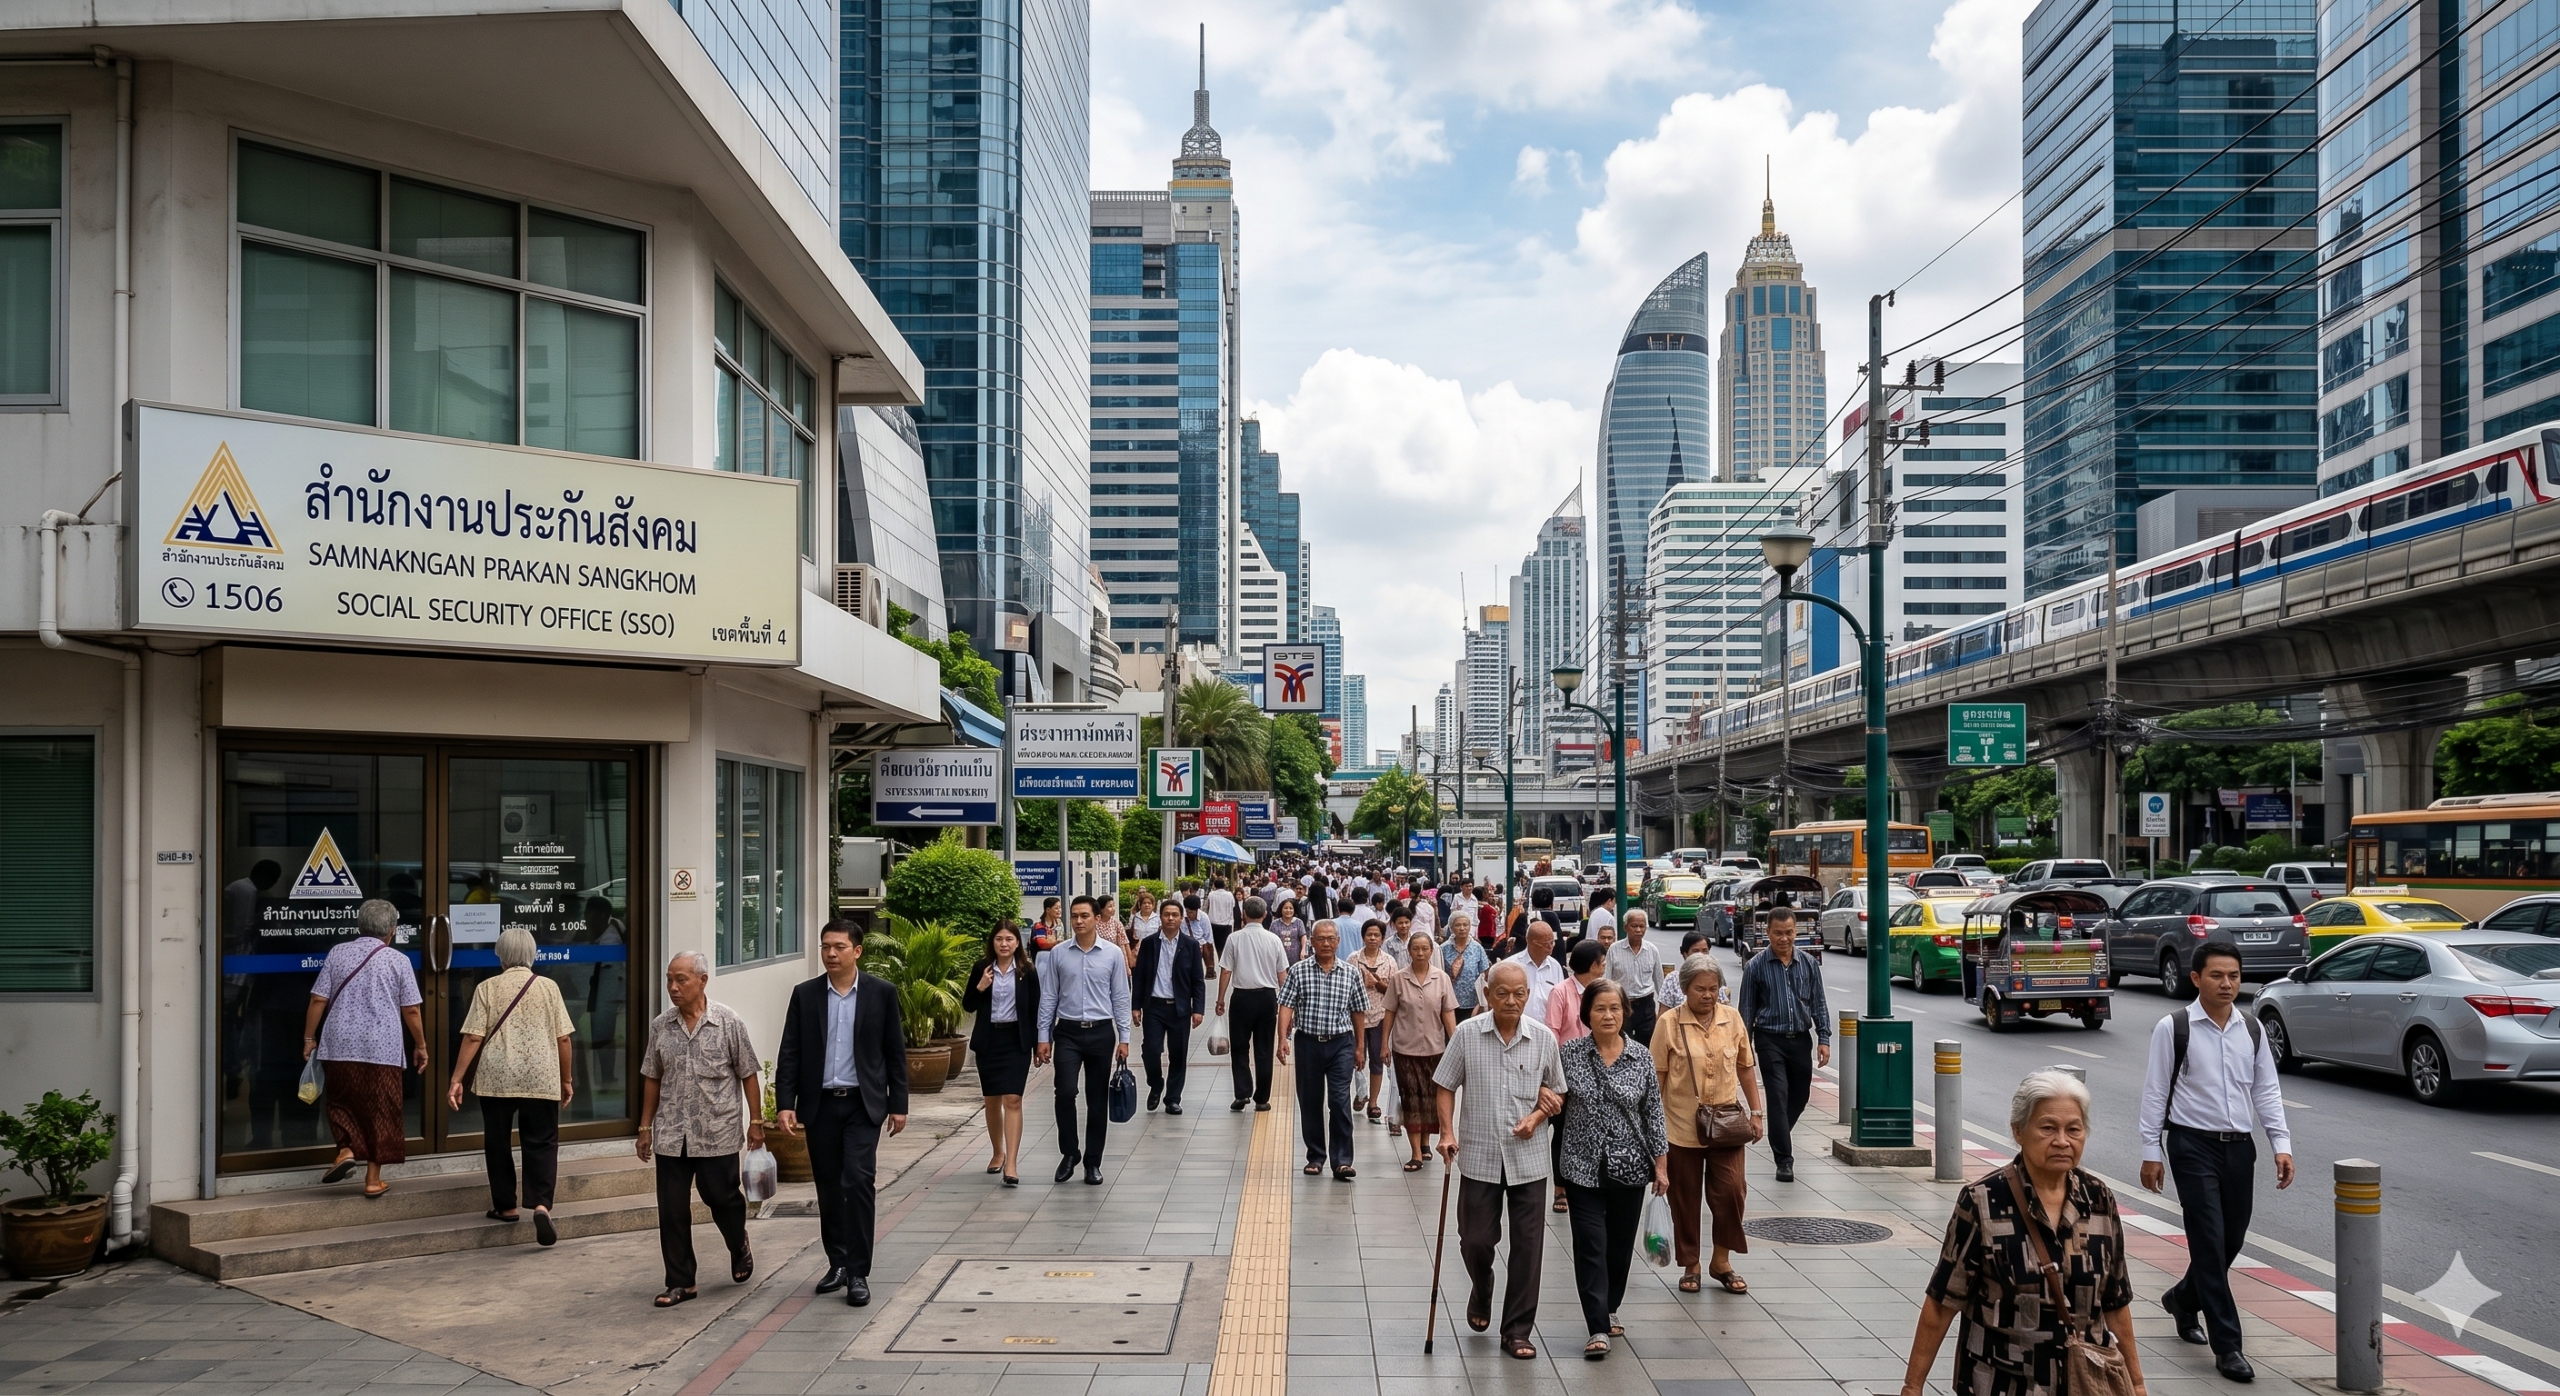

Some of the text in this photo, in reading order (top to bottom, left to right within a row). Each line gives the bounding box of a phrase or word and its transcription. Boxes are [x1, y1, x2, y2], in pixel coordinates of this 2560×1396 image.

[305, 462, 697, 554] สำนักงานประกันสังคม
[308, 541, 697, 596] SAMNAKNGAN PRAKAN SANGKHOM
[205, 582, 283, 613] 1506
[336, 591, 675, 639] SOCIAL SECURITY OFFICE (SSO)
[712, 615, 787, 646] เขตพื้นที่ 4
[1273, 652, 1315, 660] BTS
